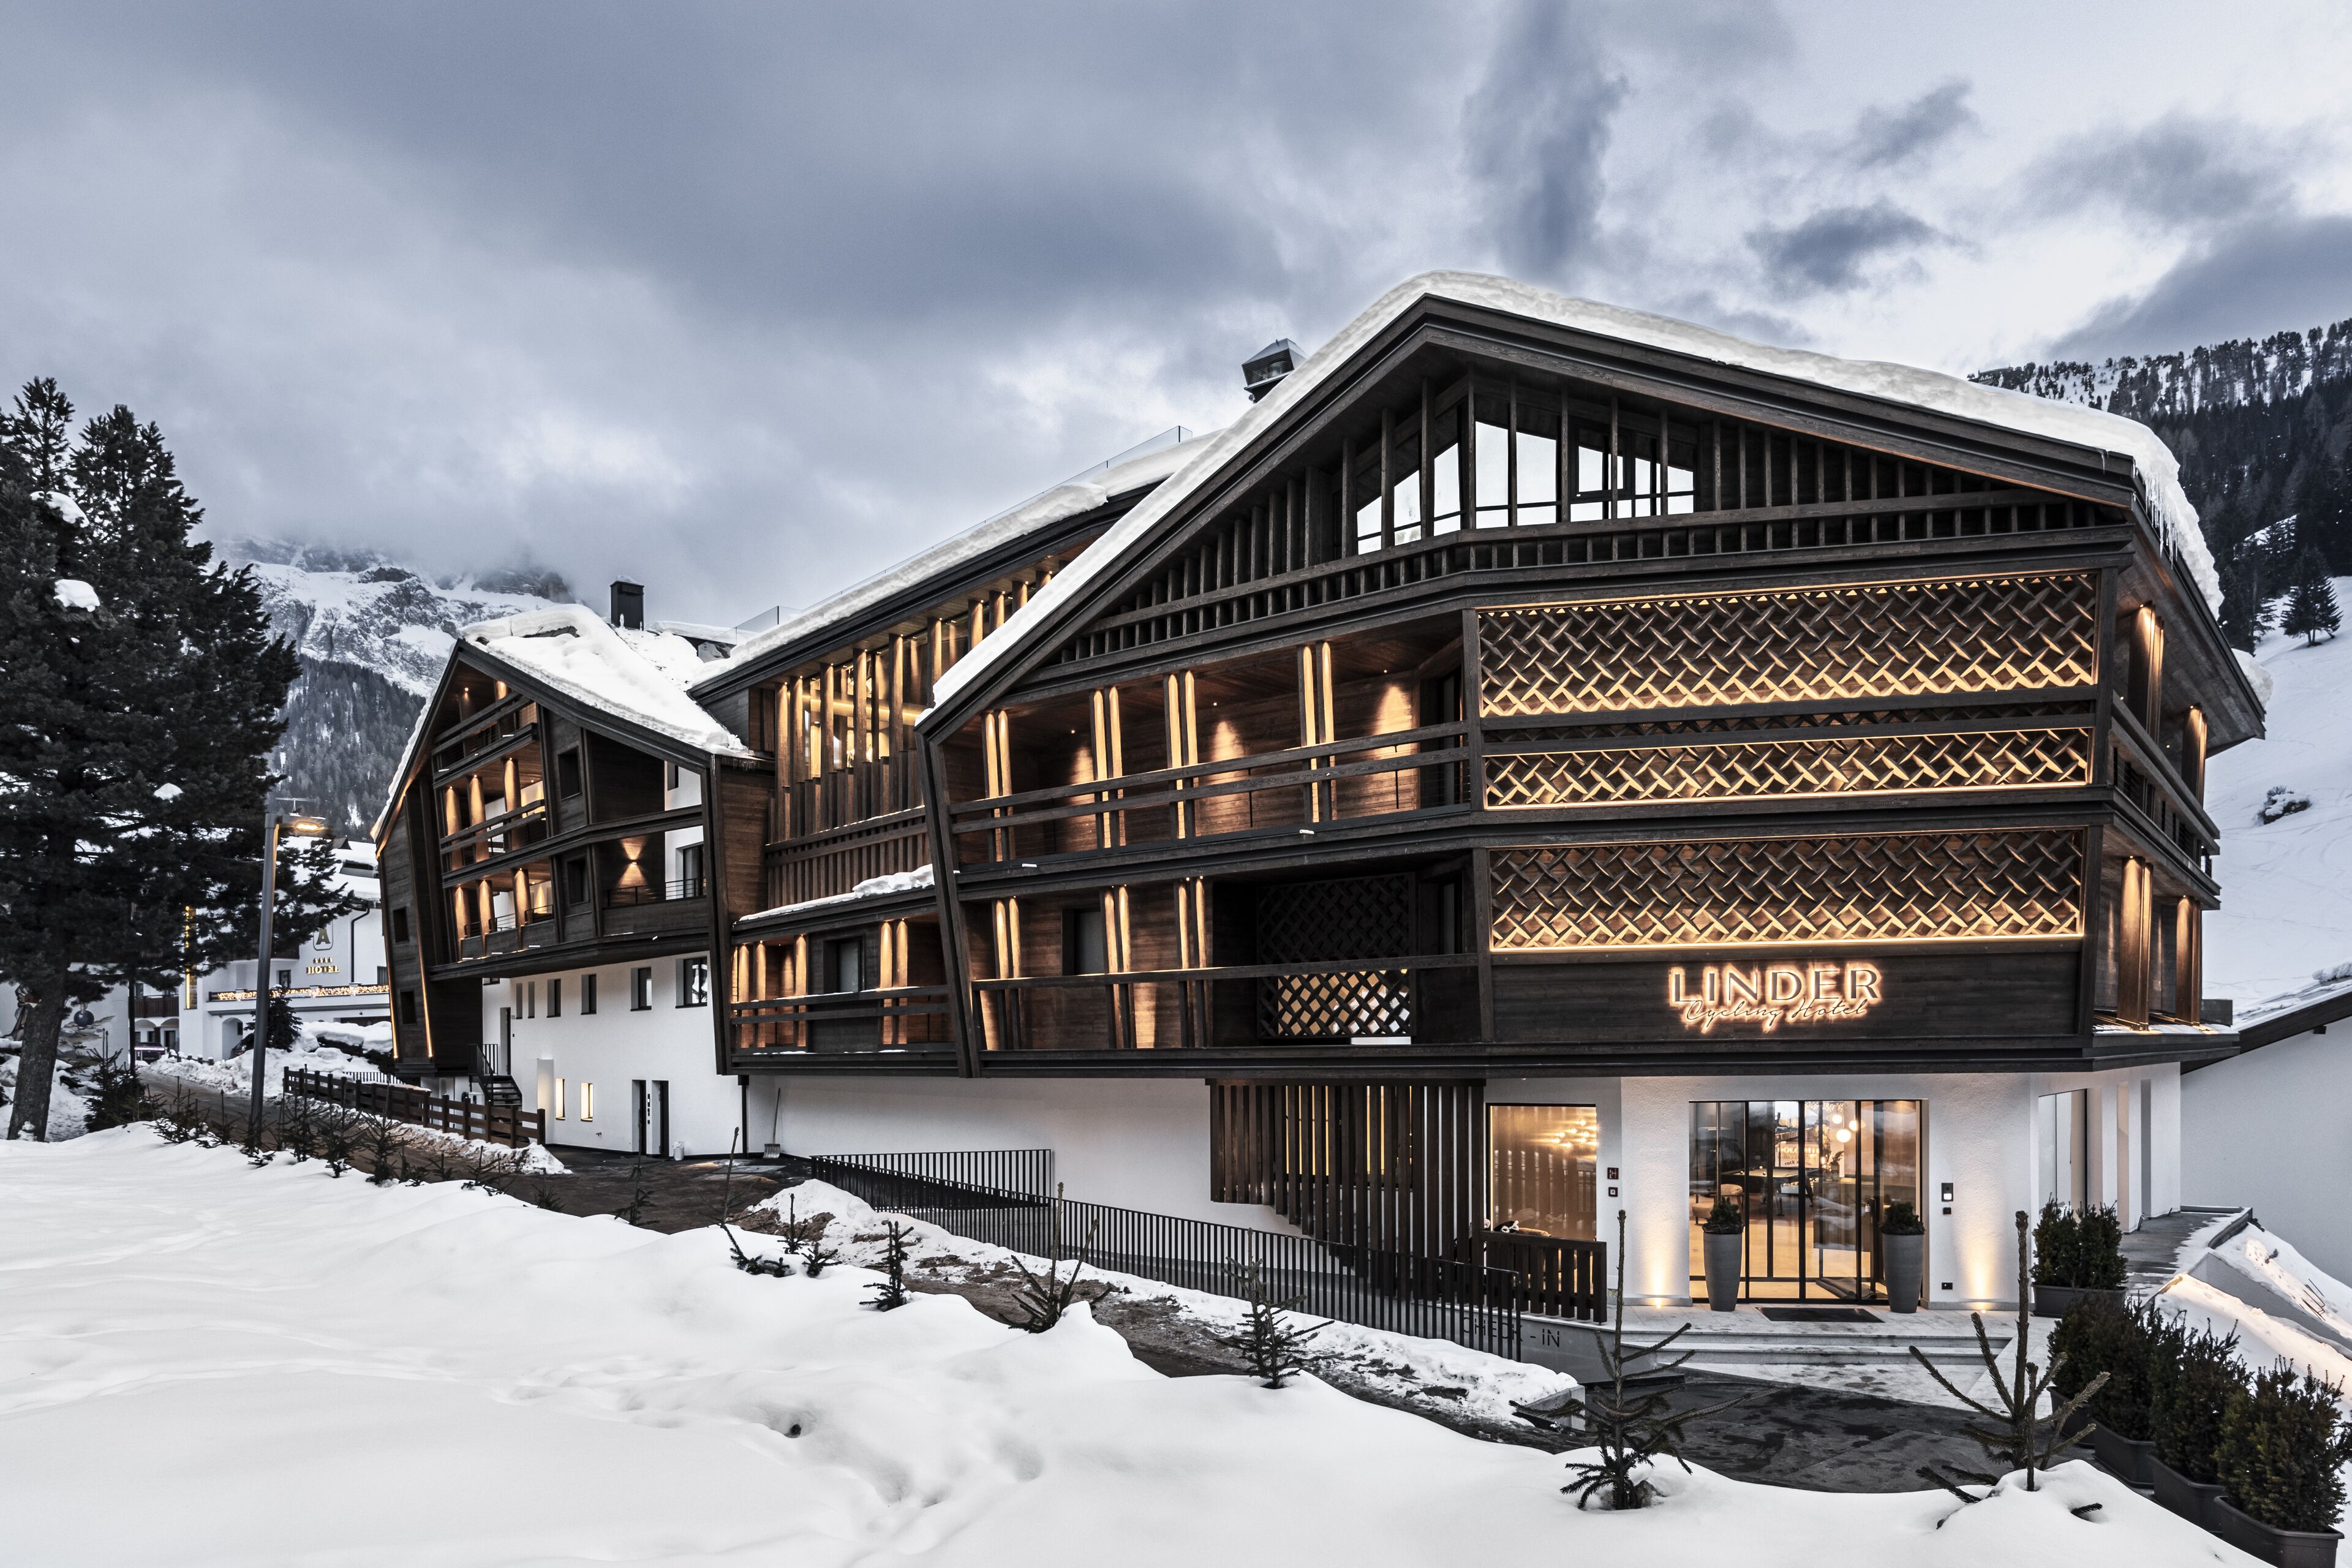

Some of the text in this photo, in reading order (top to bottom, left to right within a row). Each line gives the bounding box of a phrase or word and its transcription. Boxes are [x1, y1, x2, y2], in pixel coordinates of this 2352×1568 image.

[306, 965, 341, 974] HOTEL
[1673, 969, 1879, 1003] LINDER
[1686, 997, 1866, 1028] Cycling Hotel
[1542, 1328, 1560, 1348] IN
